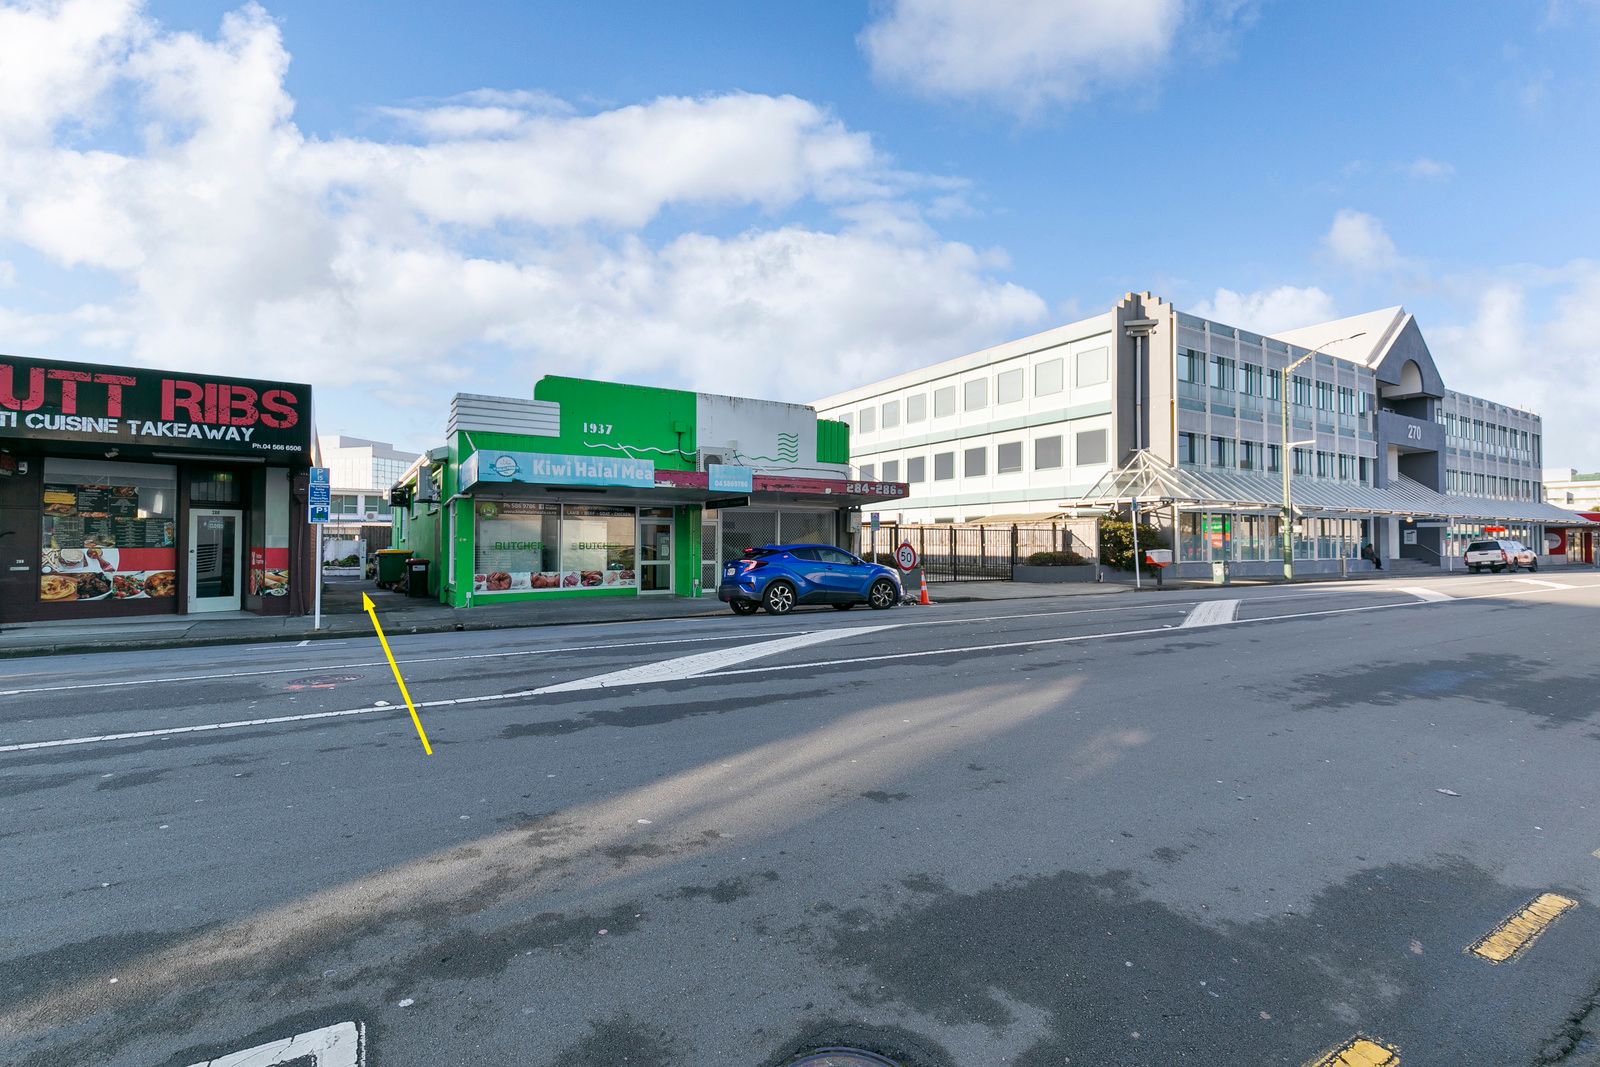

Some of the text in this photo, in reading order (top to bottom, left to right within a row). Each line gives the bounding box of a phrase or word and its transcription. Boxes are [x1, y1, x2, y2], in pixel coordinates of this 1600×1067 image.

[0, 364, 298, 429] UTT RIBS
[25, 413, 119, 434] CUISINE
[126, 420, 255, 442] TAKEAWAY
[583, 422, 613, 435] 1937
[1407, 424, 1421, 440] 270
[533, 459, 571, 477] Kiwi
[575, 462, 618, 479] Halal
[622, 464, 655, 481] Mea
[846, 483, 897, 495] 284-286
[494, 541, 545, 551] BUTCHER
[900, 551, 912, 562] 50
